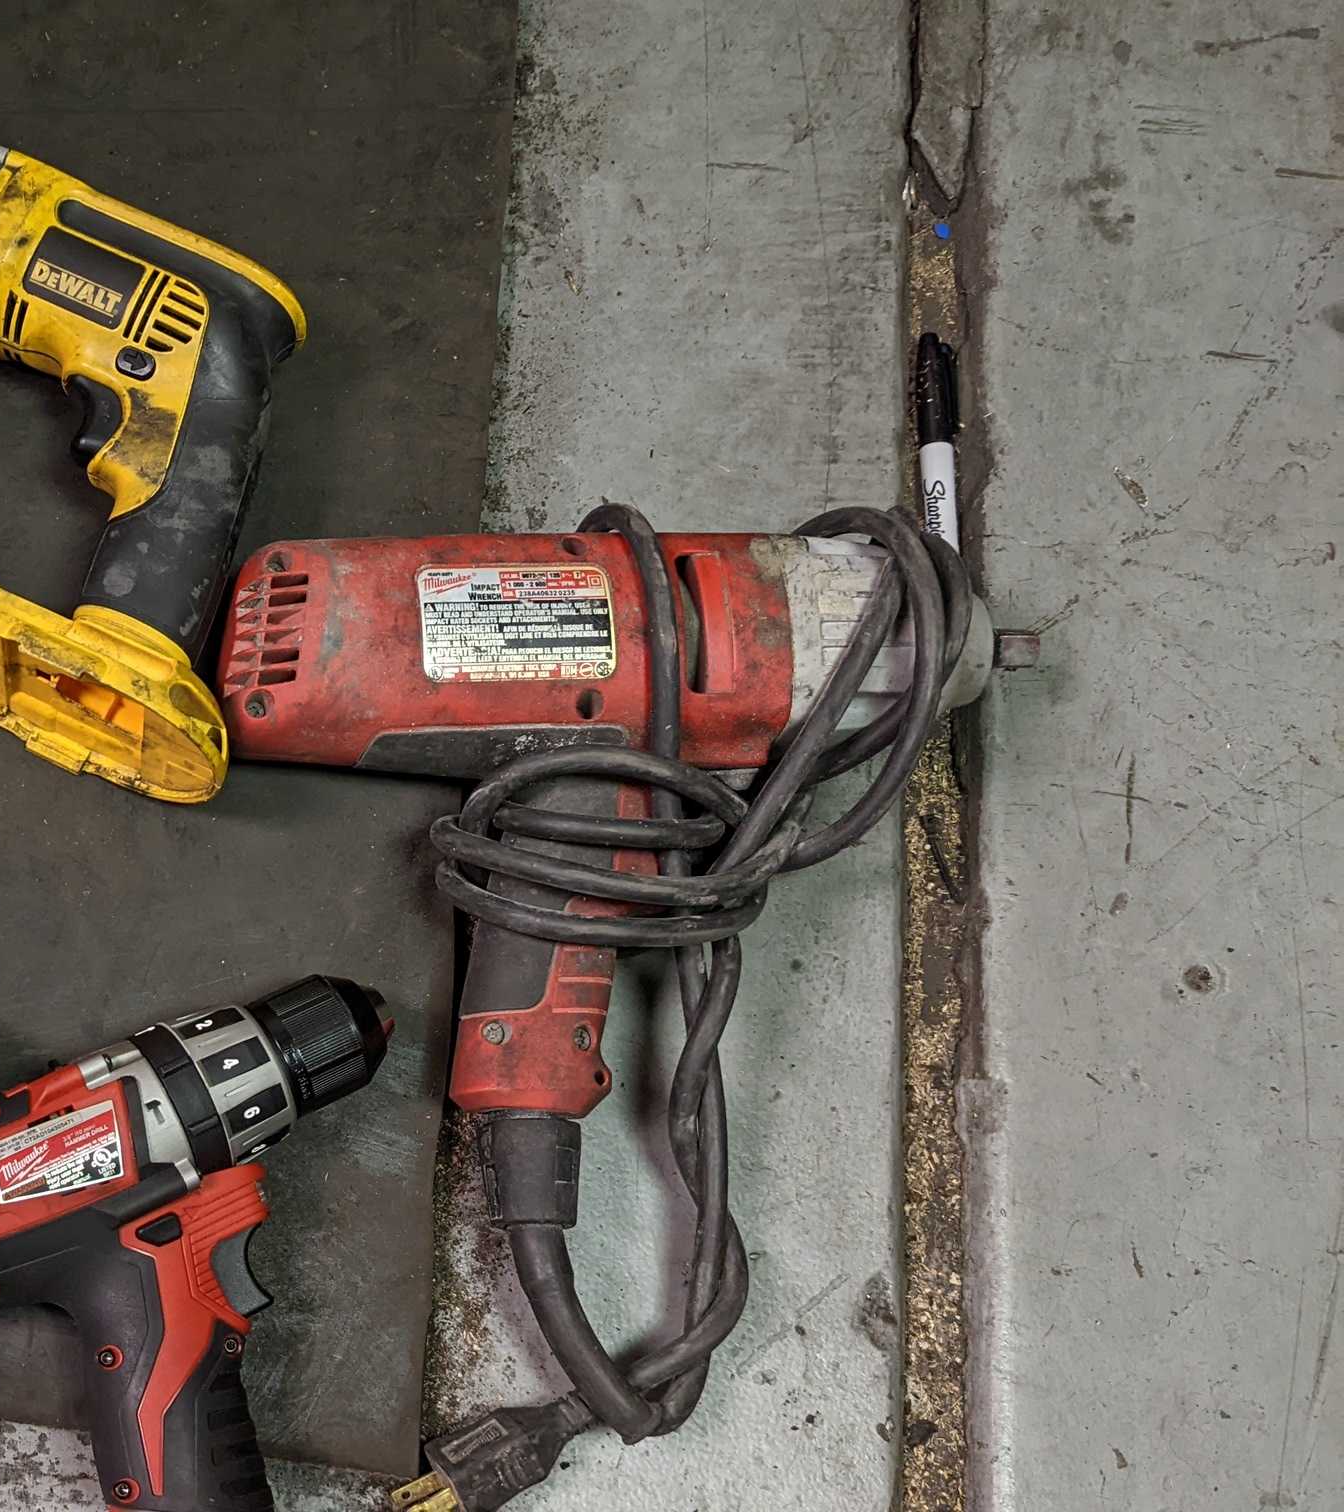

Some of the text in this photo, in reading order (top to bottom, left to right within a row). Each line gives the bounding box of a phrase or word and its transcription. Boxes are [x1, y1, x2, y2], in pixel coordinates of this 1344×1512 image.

[422, 573, 472, 591] Milwaukee
[471, 583, 500, 591] IMPACT
[468, 592, 502, 600] WRENCH
[435, 603, 479, 611] WARNING!
[427, 624, 499, 634] AVERTISSEMENT!
[196, 1020, 213, 1030] 2
[223, 1059, 239, 1070] 4
[244, 1105, 260, 1119] 6
[64, 1125, 108, 1148] HAMMER DRILL
[83, 1153, 91, 1161] of
[97, 1161, 116, 1174] LISTED
